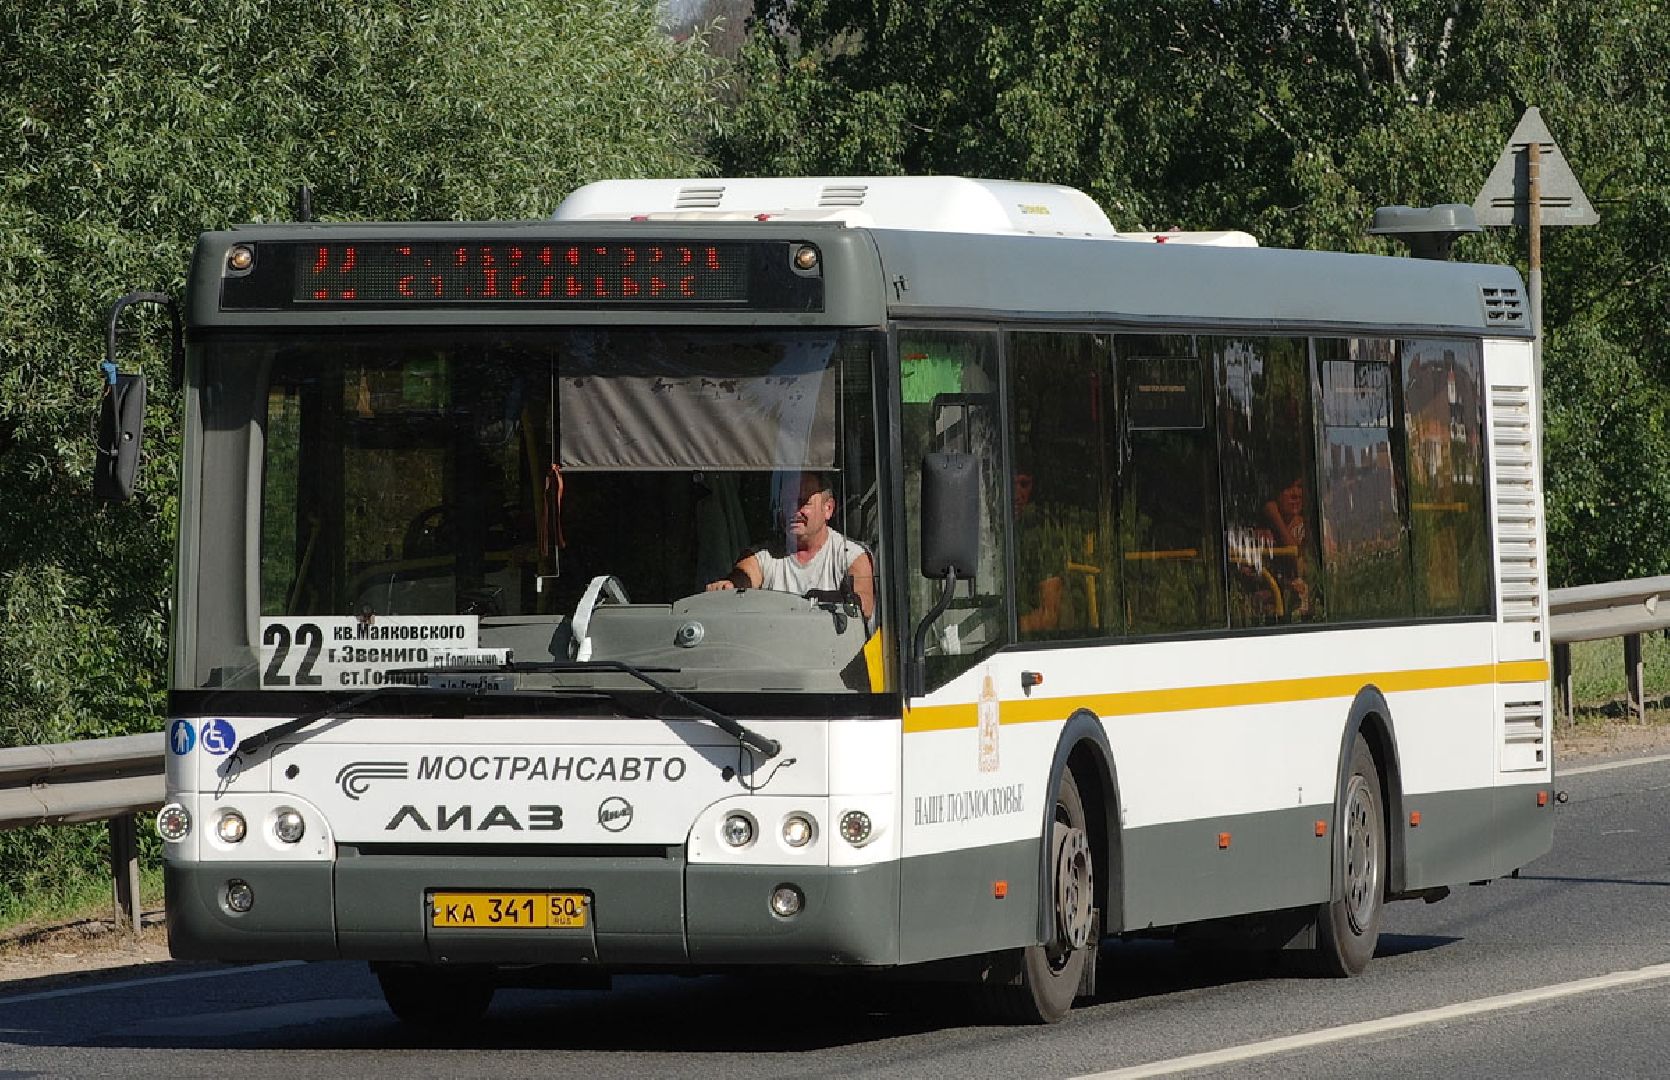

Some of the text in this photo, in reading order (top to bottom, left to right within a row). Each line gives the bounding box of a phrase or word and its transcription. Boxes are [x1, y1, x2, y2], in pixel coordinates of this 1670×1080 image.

[333, 624, 465, 640] кв.Маяковского
[263, 623, 323, 687] 22
[328, 646, 428, 663] г.Звениго
[417, 756, 687, 782] МОСТРАНСАВТО
[384, 804, 564, 831] ЛИАЗ
[914, 783, 1025, 826] НАШЕ ПОДМОСКОВЬЕ
[488, 898, 534, 924] 341
[551, 897, 575, 916] 50
